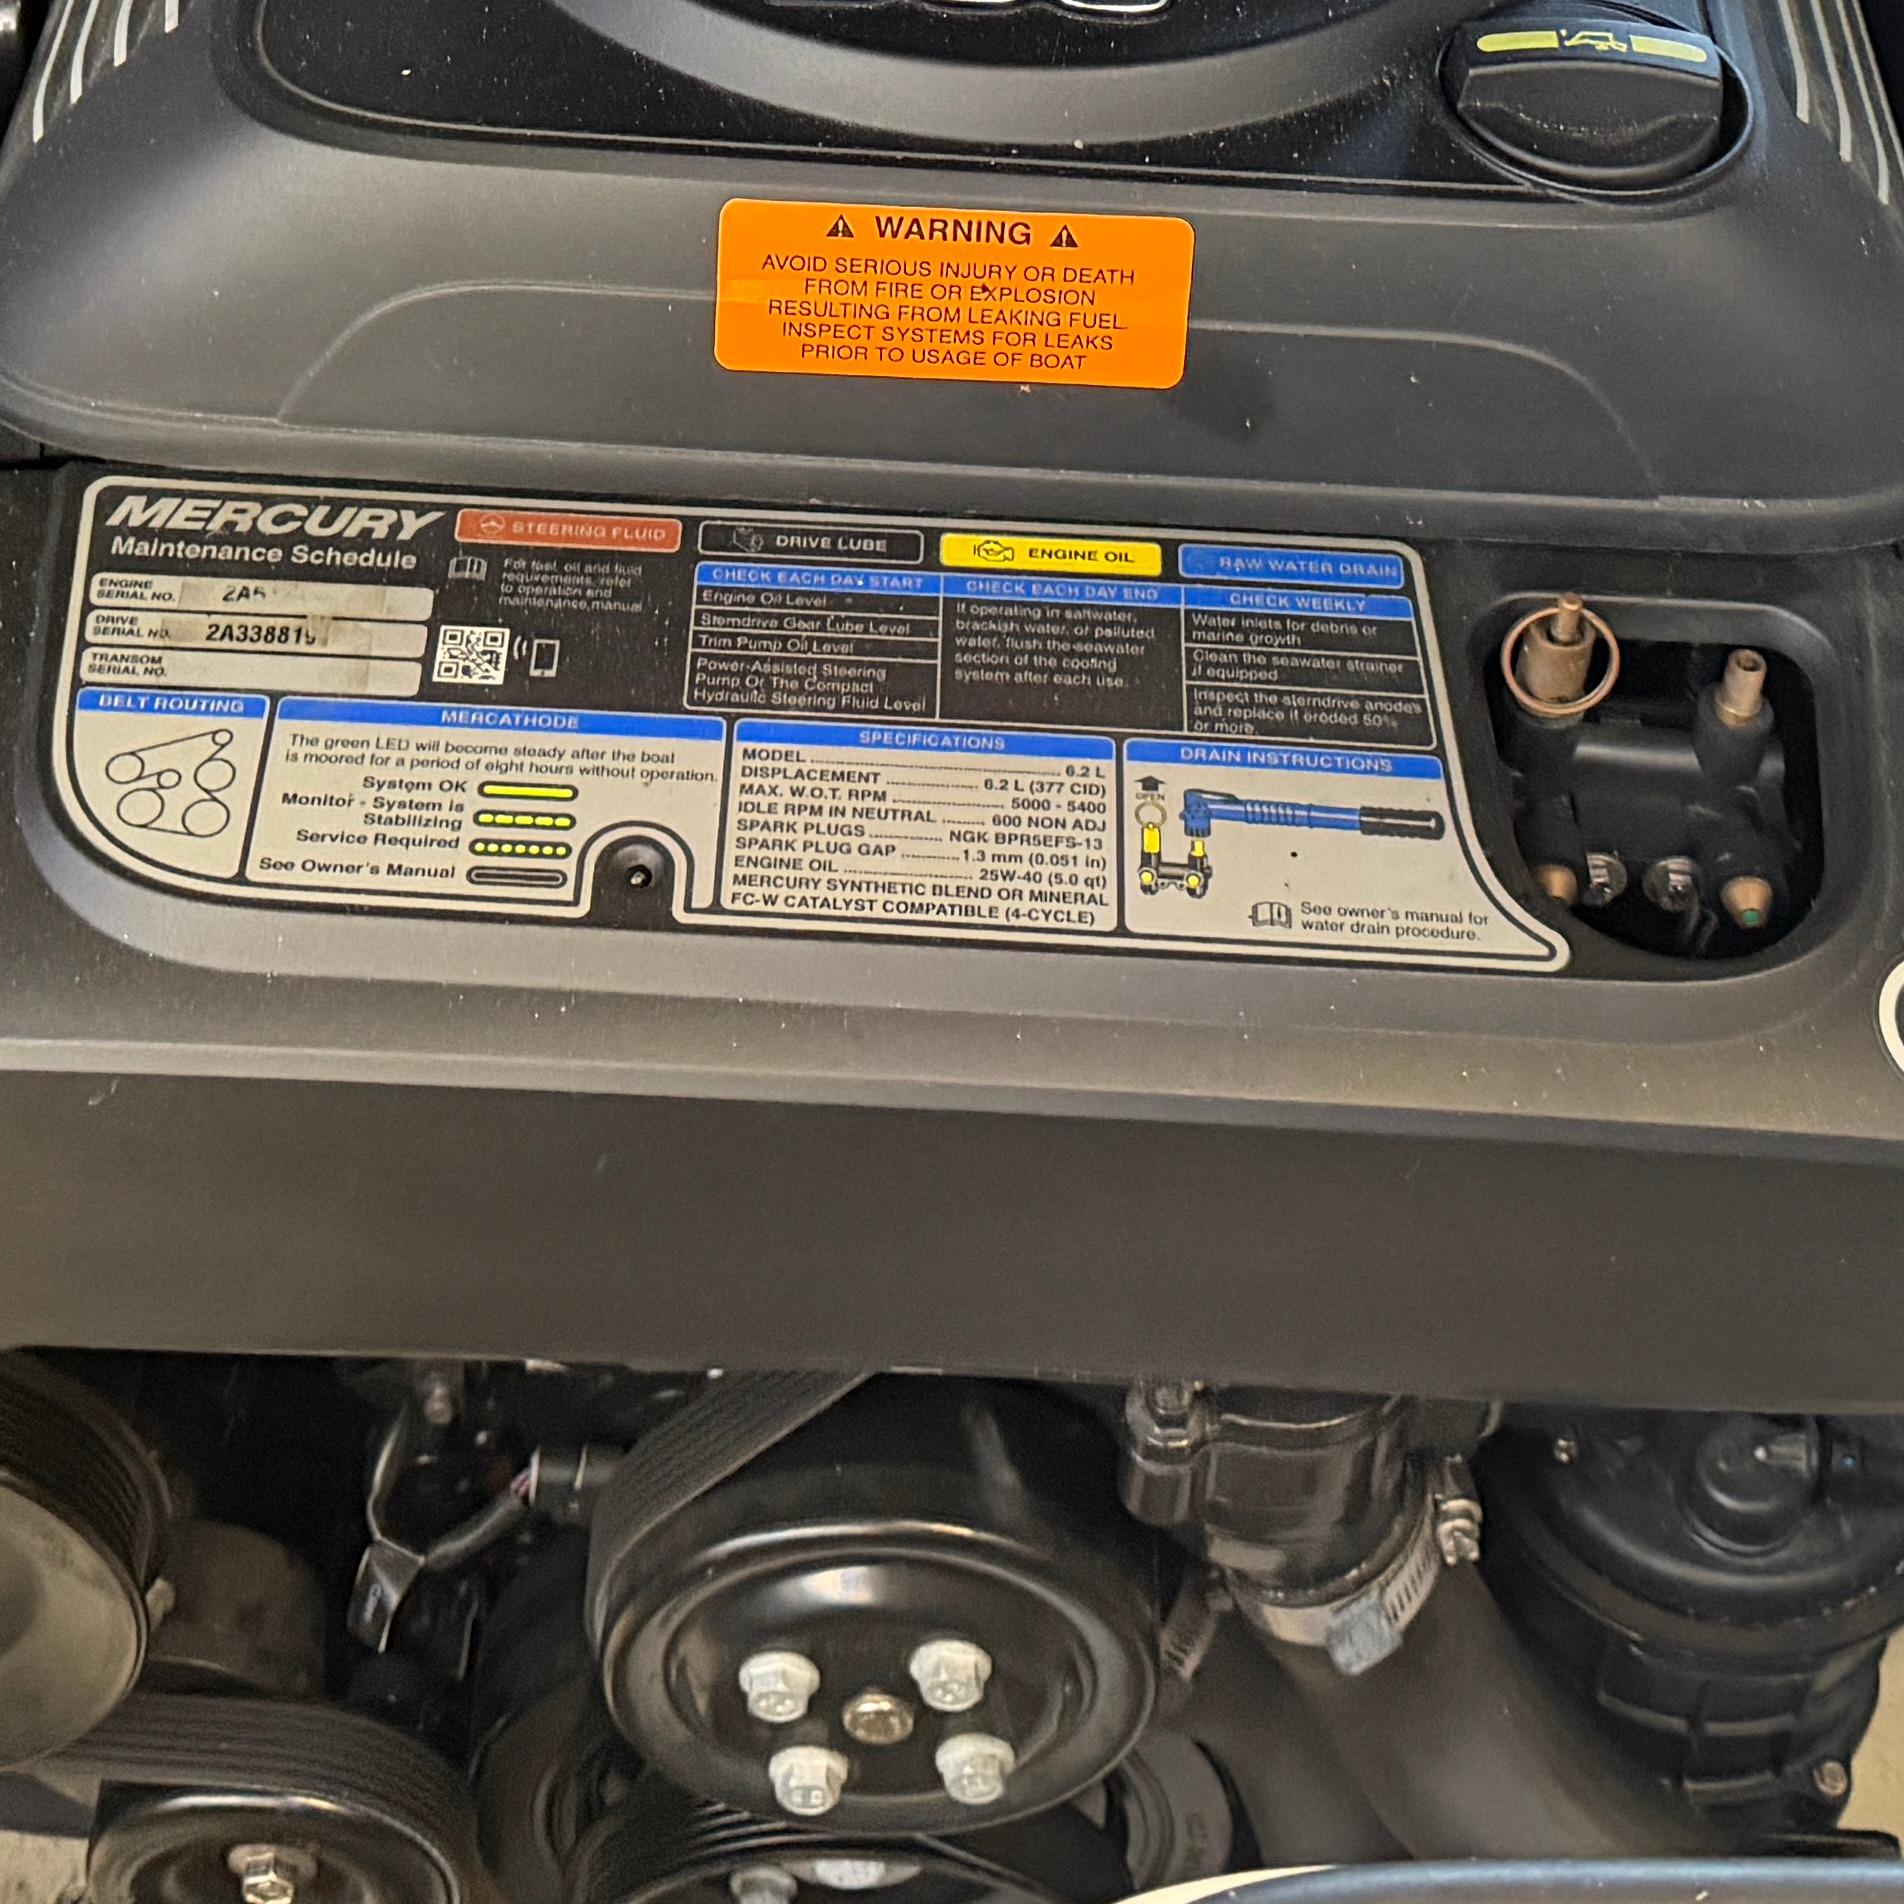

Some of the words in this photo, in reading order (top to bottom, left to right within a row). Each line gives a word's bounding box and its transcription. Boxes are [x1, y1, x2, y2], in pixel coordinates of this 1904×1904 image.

[875, 215, 1031, 245] WARNING
[762, 254, 827, 272] AVOID
[835, 257, 931, 277] SERIOUS
[940, 262, 1017, 280] INJURY
[1024, 266, 1055, 282] OR
[1063, 268, 1135, 284] DEATH
[805, 278, 867, 296] FROM
[876, 282, 922, 298] FIRE
[931, 284, 961, 301] OR
[970, 284, 1095, 306] EXPLOSION
[769, 299, 889, 320] RESULTING
[898, 305, 960, 322] FROM
[968, 307, 1060, 327] LEAKING
[783, 322, 875, 340] INSPECT
[882, 326, 984, 345] SYSTEMS
[992, 331, 1036, 346] FOR
[1045, 333, 1113, 350] LEAKS
[802, 344, 867, 360] PRIOR
[876, 347, 904, 362] TO
[912, 349, 986, 365] USAGE
[994, 352, 1022, 367] OF
[1030, 354, 1087, 369] BOAT
[106, 496, 446, 541] MERCURY
[512, 522, 606, 538] STEERING
[612, 526, 666, 541] FLUID
[776, 535, 831, 549] DRIVE
[838, 537, 887, 552] LUBE
[111, 536, 282, 564] Maintenance
[290, 545, 417, 570] Schedule
[1028, 548, 1099, 561] ENGINE
[1104, 551, 1134, 563] OIL
[712, 568, 771, 583] CHECK
[778, 571, 825, 585] EACH
[831, 574, 865, 586] DAY
[870, 576, 922, 589] START
[1219, 556, 1262, 572] RAW
[1268, 559, 1331, 575] WATER
[1339, 563, 1397, 577] DRAIN
[703, 590, 755, 604] Engine
[786, 594, 826, 607] Level
[966, 580, 1025, 594] CHECK
[1032, 582, 1079, 597] EACH
[1085, 585, 1117, 598] DAY
[1123, 588, 1158, 601] END
[1229, 592, 1289, 609] CHECK
[1296, 595, 1365, 612] WEEKLY
[98, 694, 150, 709] BELT
[154, 696, 244, 713] ROUTING
[442, 710, 578, 729] MERCATHODE
[289, 733, 319, 747] The
[325, 737, 369, 750] green
[376, 737, 409, 751] LED
[416, 741, 439, 753] will
[445, 743, 508, 755] become
[513, 744, 565, 761] steady
[571, 747, 607, 760] after
[612, 749, 636, 762] the
[641, 750, 675, 764] boat
[860, 730, 1005, 750] SPECIFICATIONS
[742, 748, 806, 763] MODEL
[1096, 766, 1105, 778] L
[1180, 747, 1241, 764] DRAIN
[1247, 752, 1393, 772] INSTRUCTIONS
[363, 776, 431, 793] System
[439, 780, 468, 793] OK
[741, 766, 880, 784] DISPLACEMENT
[1014, 779, 1024, 792] L
[1029, 780, 1064, 794] (377
[1070, 783, 1106, 798] CID)
[282, 793, 354, 808] Monitor
[373, 796, 442, 813] System
[449, 799, 464, 813] is
[739, 784, 783, 797] MAX.
[790, 786, 841, 800] W.O.T.
[848, 789, 887, 802] RPM
[1011, 797, 1050, 811] 5000
[1067, 801, 1106, 814] 5400
[363, 813, 463, 832] Stabilizing
[738, 801, 778, 814] IDLE
[784, 804, 823, 817] RPM
[829, 806, 845, 818] IN
[852, 807, 936, 823] NEUTRAL
[992, 814, 1021, 828] 600
[1027, 816, 1067, 830] NON
[1072, 818, 1106, 833] ADJ
[296, 829, 367, 844] Service
[374, 833, 459, 851] Required
[736, 818, 797, 833] SPARK
[804, 823, 865, 837] PLUGS
[949, 830, 989, 843] NGK
[735, 837, 796, 852] SPARK
[802, 841, 851, 855] PLUG
[858, 843, 897, 856] GAP
[962, 849, 986, 862] 1.3
[992, 853, 1023, 864] mm
[1029, 853, 1078, 868] (0.051
[1085, 856, 1107, 870] in)
[259, 857, 294, 871] See
[301, 859, 379, 875] Owner's
[387, 863, 456, 879] Manual
[734, 855, 803, 870] ENGINE
[809, 859, 839, 872] OIL
[979, 868, 1042, 884] 25W-40
[1048, 872, 1079, 886] (5.0
[1084, 875, 1107, 890] qt)
[732, 874, 821, 890] MERCURY
[826, 879, 926, 897] SYNTHETIC
[932, 884, 992, 900] BLEND
[997, 888, 1023, 901] OR
[1029, 889, 1109, 906] MINERAL
[730, 892, 778, 907] FC-W
[784, 895, 878, 912] CATALYST
[882, 900, 999, 919] COMPATIBLE
[1005, 907, 1095, 925] (4-CYCLE)
[1301, 901, 1332, 915] See
[1338, 906, 1399, 920] owner's
[1405, 910, 1463, 924] manual
[1469, 911, 1490, 925] for
[1301, 919, 1346, 932] water
[1350, 922, 1390, 935] drain
[1395, 926, 1481, 941] procedure.
